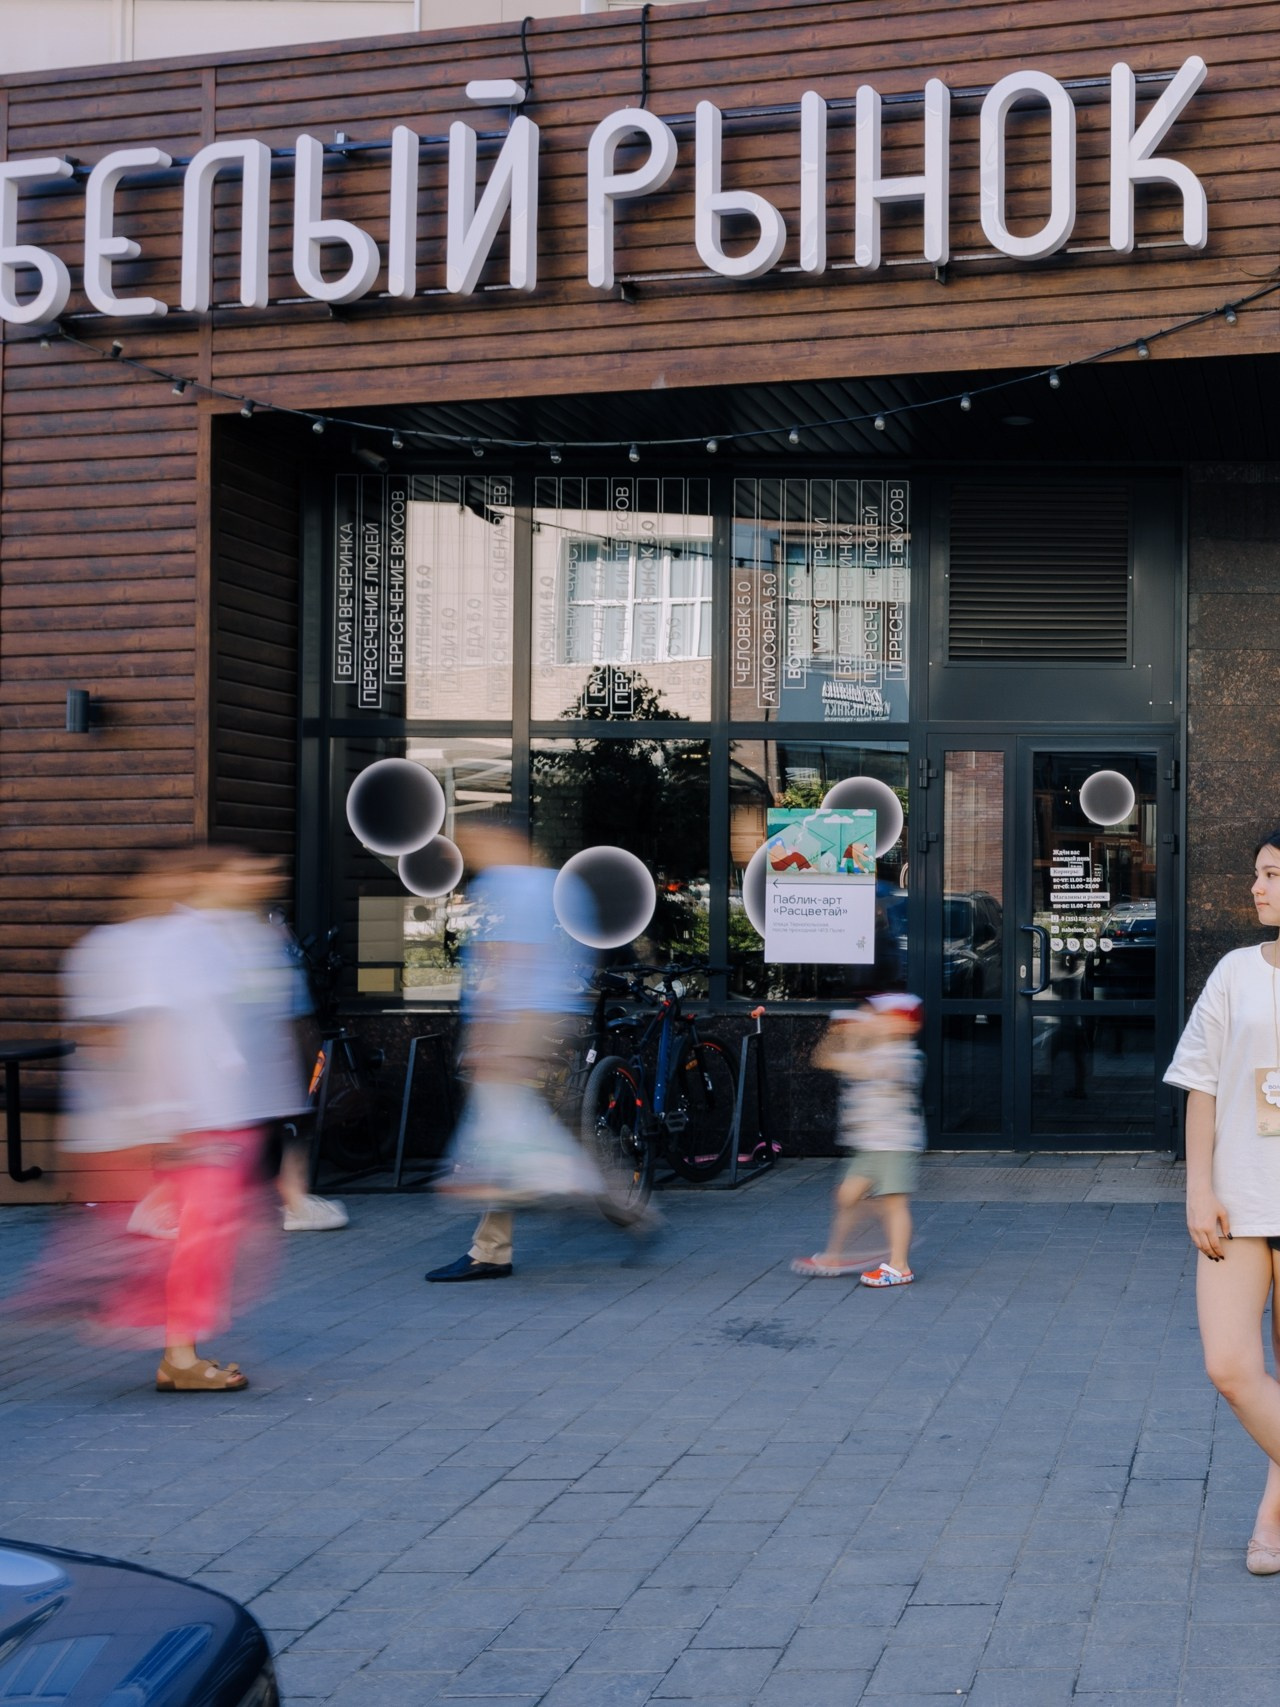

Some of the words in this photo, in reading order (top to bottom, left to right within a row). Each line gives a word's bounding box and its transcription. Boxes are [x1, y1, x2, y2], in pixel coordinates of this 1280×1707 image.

[0, 79, 540, 326] БЕЛЫЙ
[587, 55, 1209, 291] РЫНОК
[362, 522, 380, 583] ЛЮДЕЙ
[391, 491, 405, 555] ВКУСОВ
[862, 506, 880, 564] ЛЮДЕЙ
[890, 488, 904, 553] ВКУСОВ
[339, 522, 353, 618] ВЕЧЕРИНКА
[762, 573, 777, 596] 5.0
[814, 518, 828, 592] ВСТРЕЧИ
[839, 523, 853, 618] ВЕЧЕРИНКА
[389, 560, 404, 676] ПЕРЕСЕЧЕНИЕ
[737, 581, 751, 605] 5.0
[814, 596, 827, 652] МЕСТО
[864, 568, 879, 683] ПЕРЕСЕЧЕНИЕ
[889, 557, 904, 672] ПЕРЕСЕЧЕНИЕ
[338, 622, 352, 675] БЕЛАЯ
[364, 586, 378, 702] ПЕРЕСЕЧЕНИЕ
[737, 608, 751, 682] ЧЕЛОВЕК
[762, 600, 777, 702] АТМОСФЕРА
[839, 622, 853, 675] БЕЛАЯ
[773, 895, 843, 908] Паблик-арт
[774, 907, 848, 917] «Расцветай»
